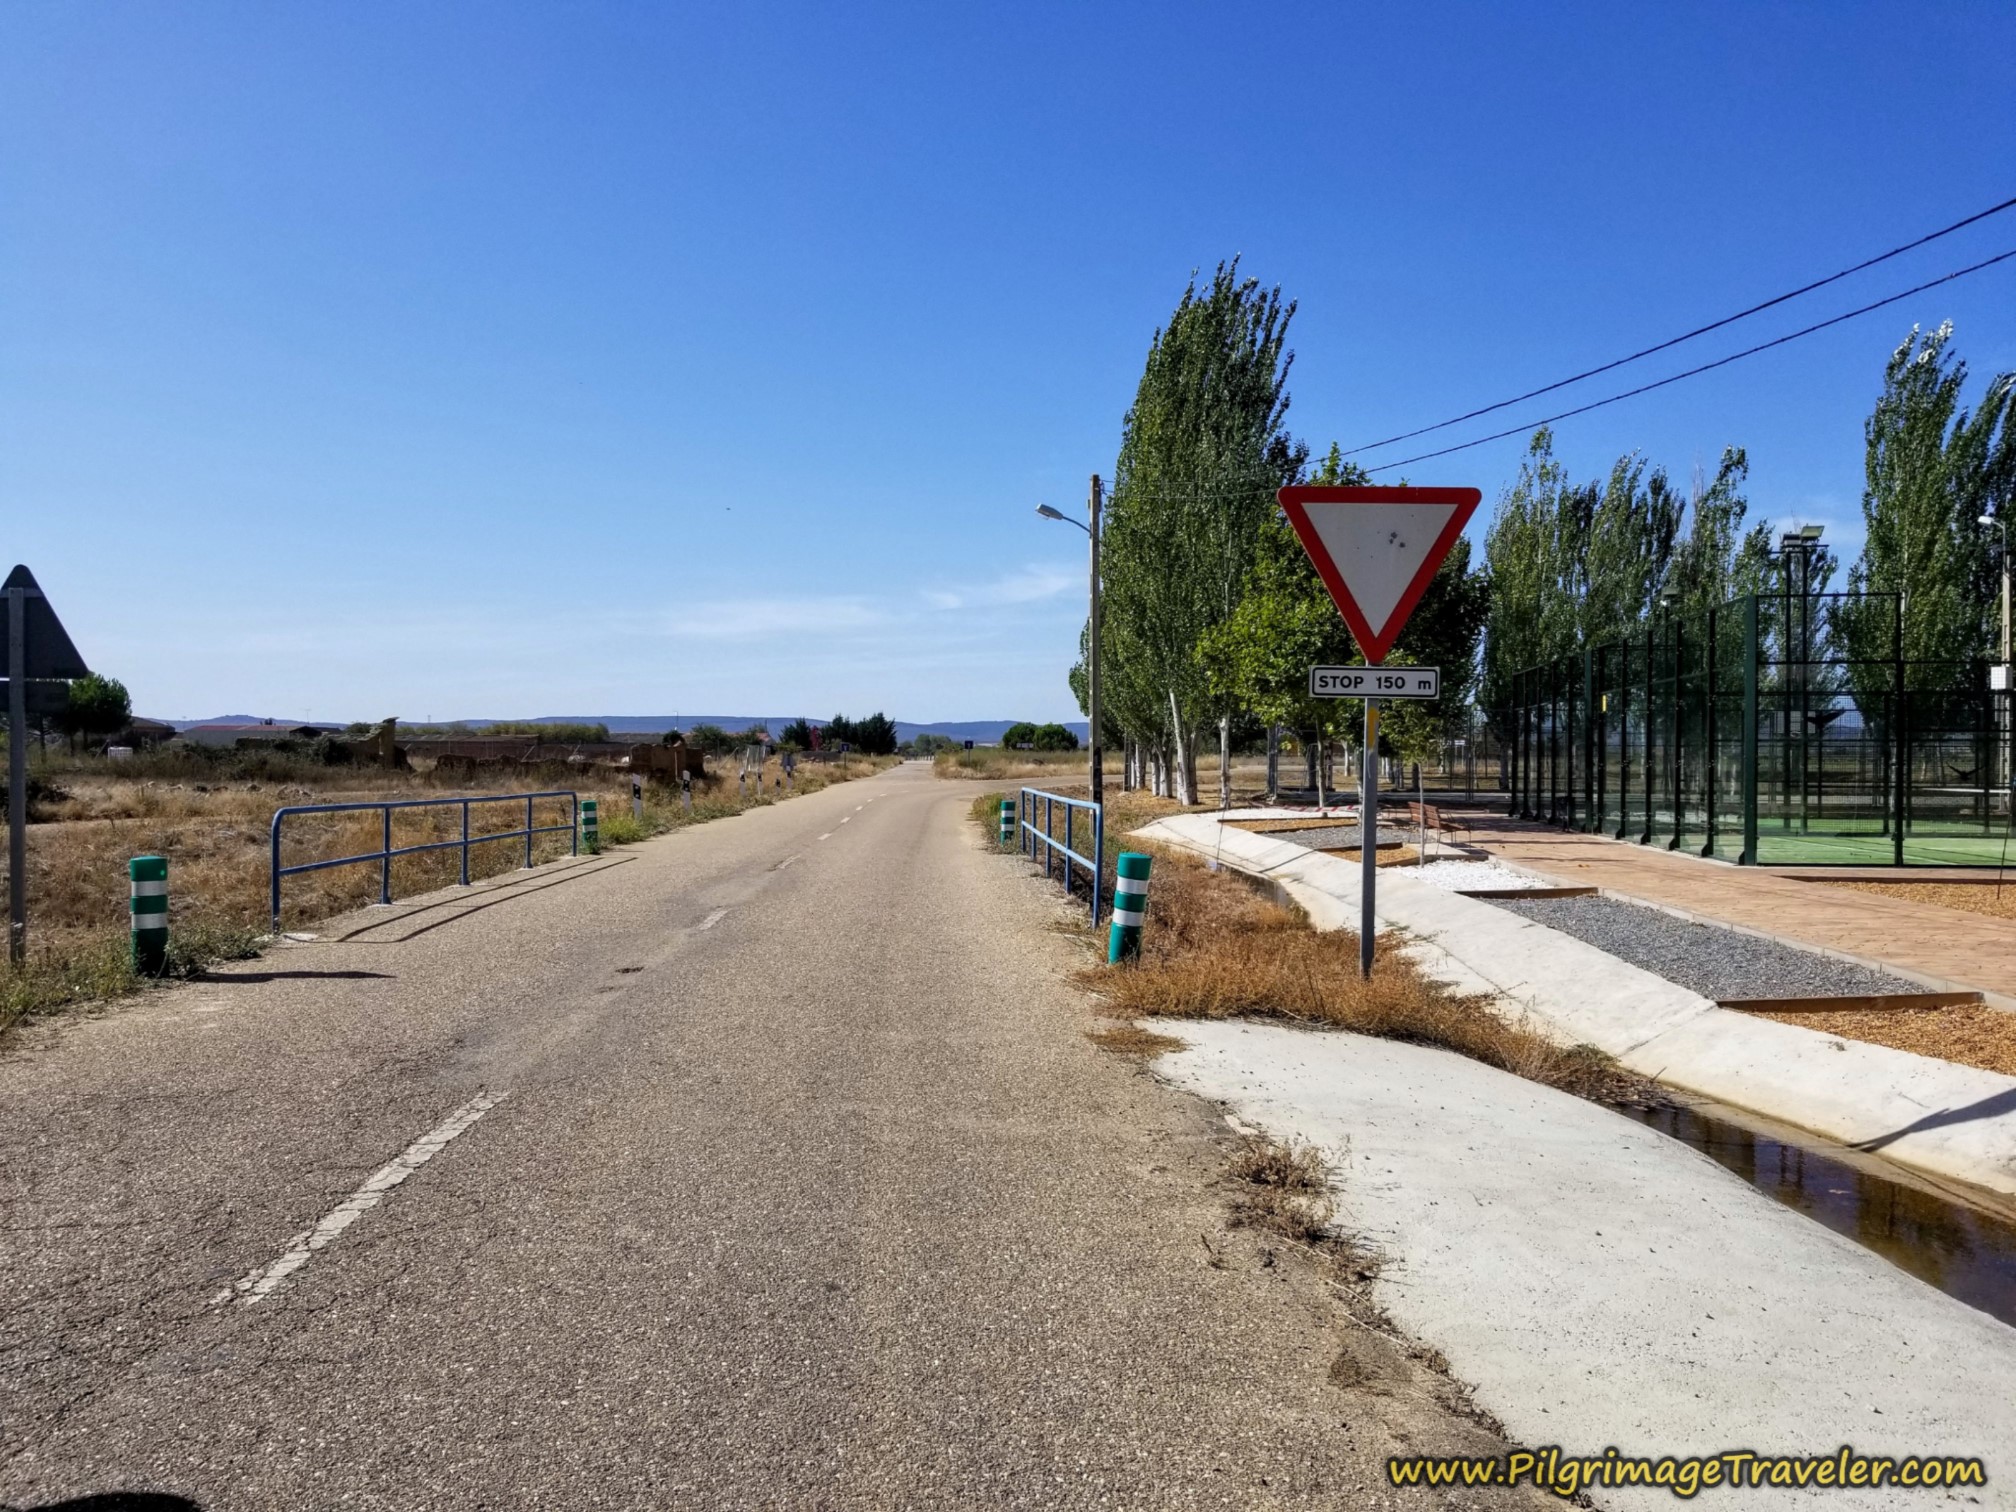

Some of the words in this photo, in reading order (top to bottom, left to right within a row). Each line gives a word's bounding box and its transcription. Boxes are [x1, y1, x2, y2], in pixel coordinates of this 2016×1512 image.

[1318, 675, 1364, 689] STOP
[1376, 676, 1406, 690] 150
[1417, 679, 1432, 690] m
